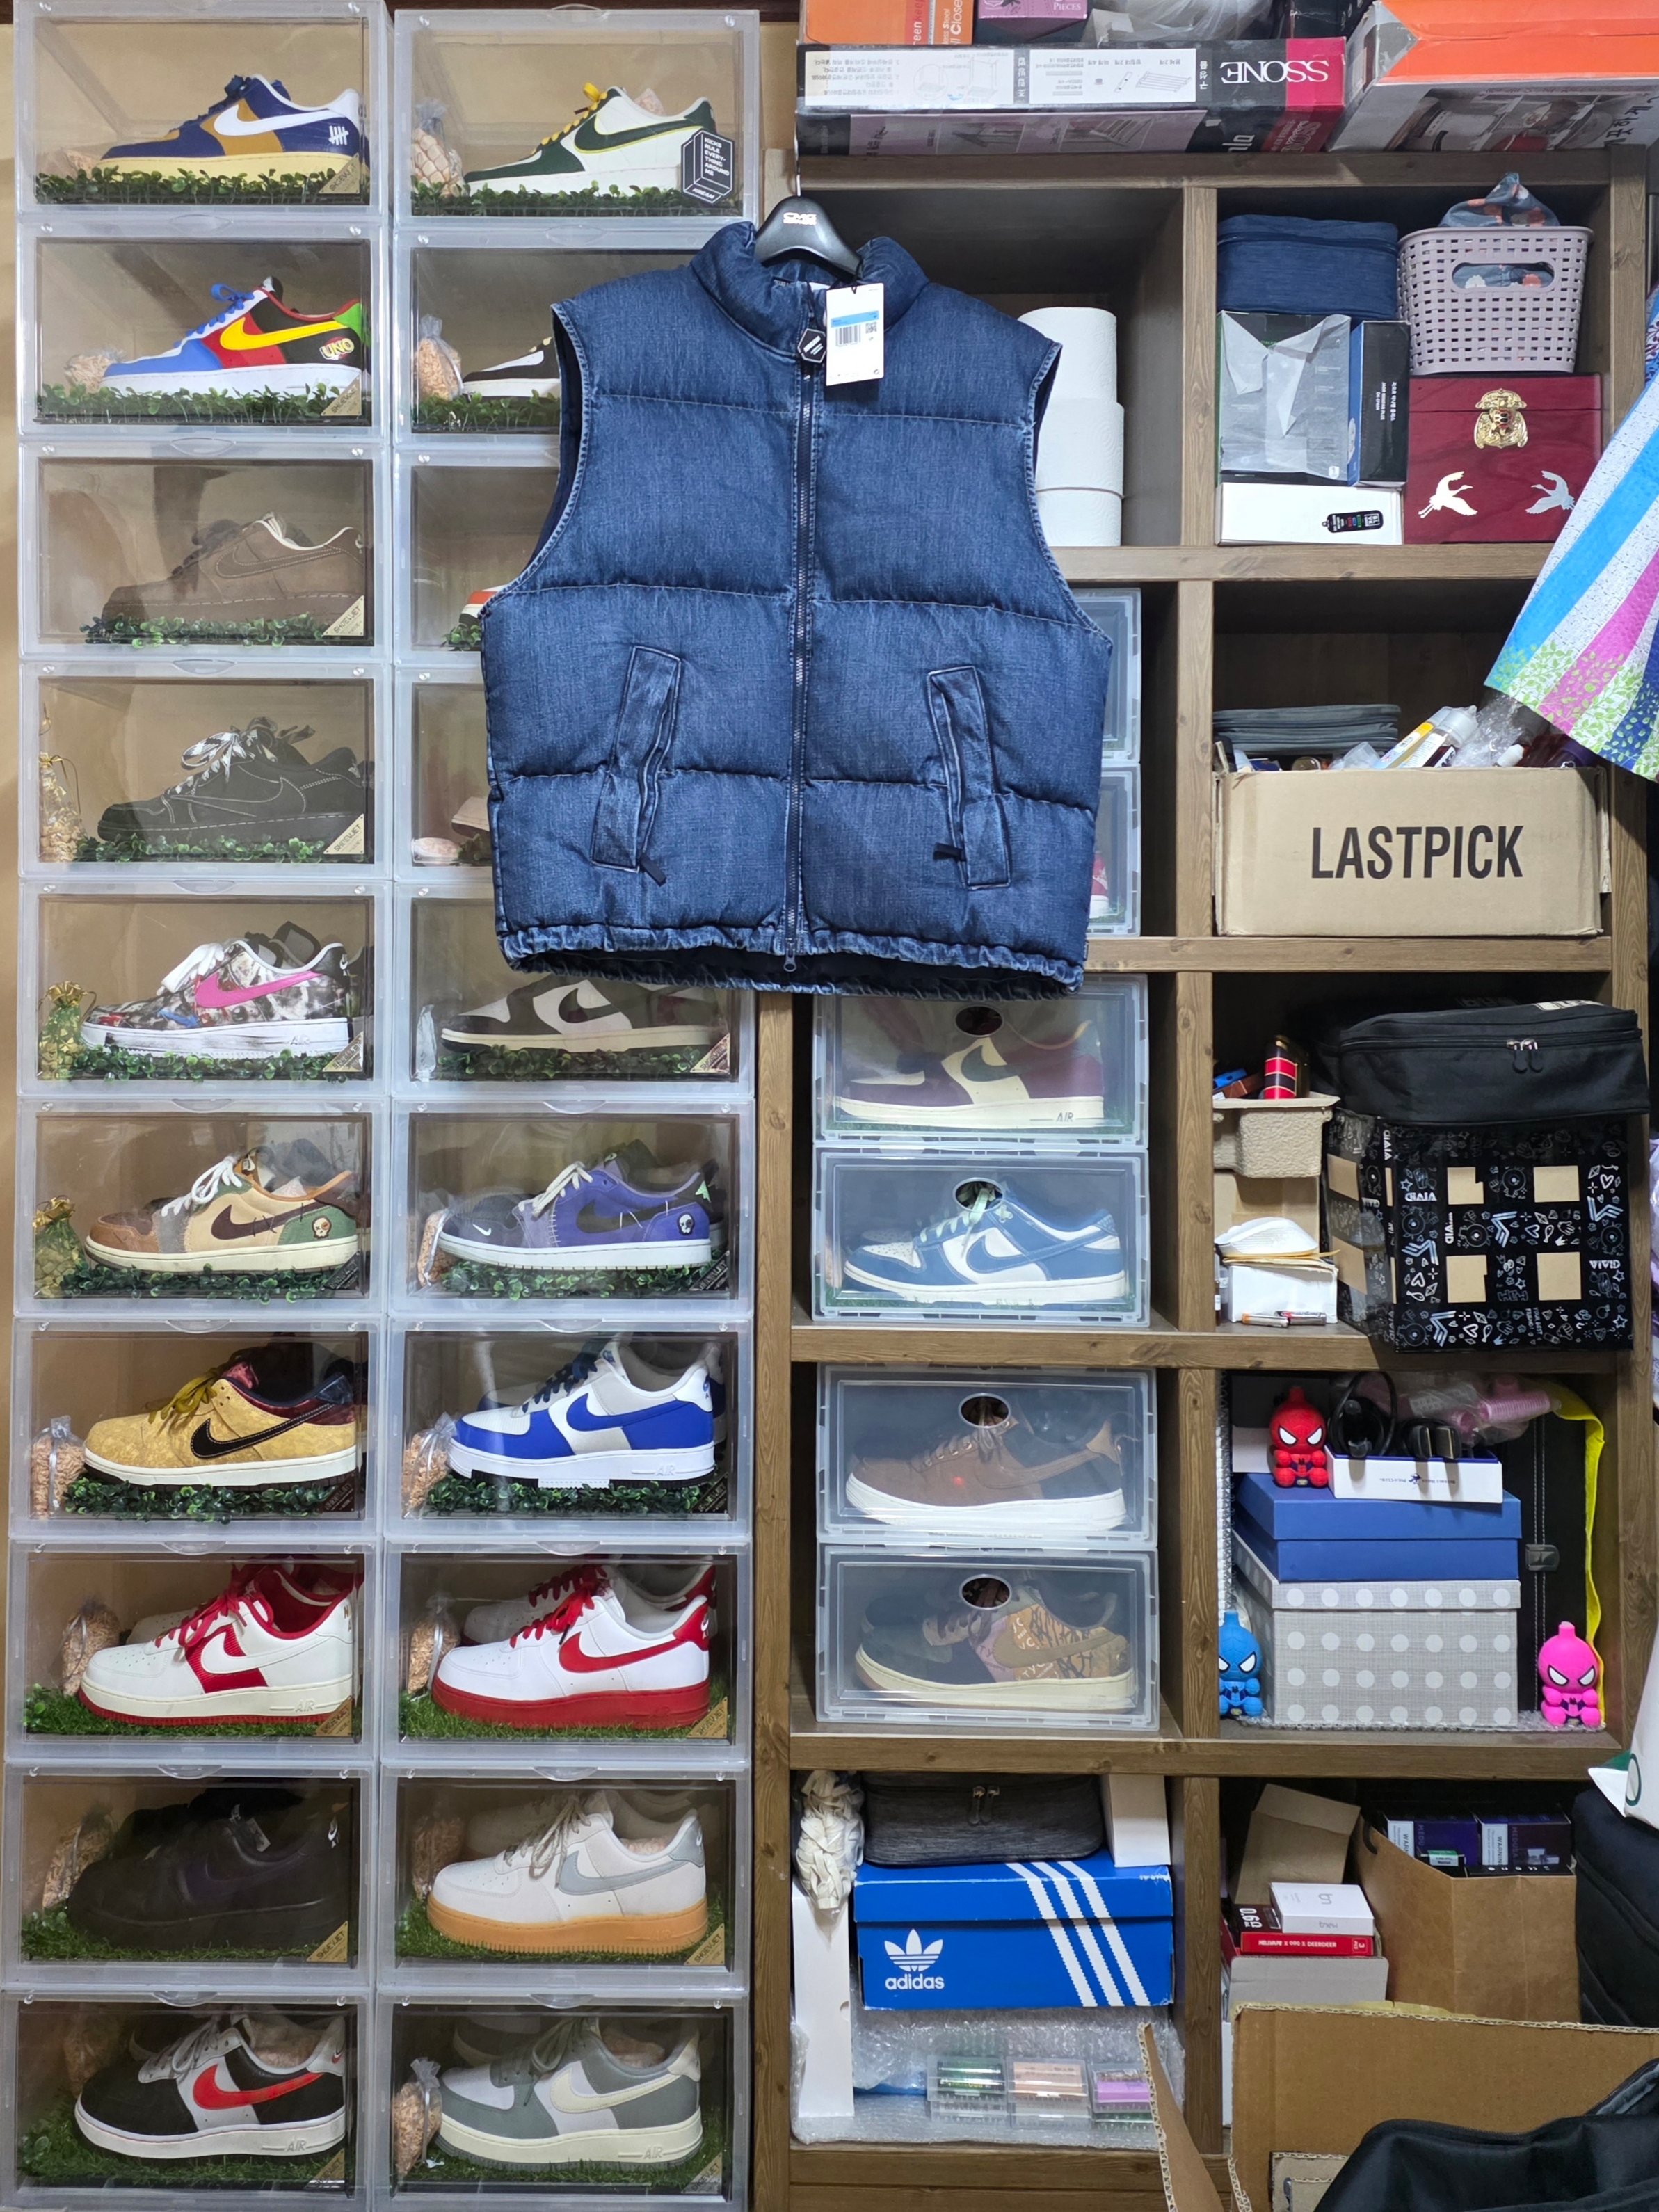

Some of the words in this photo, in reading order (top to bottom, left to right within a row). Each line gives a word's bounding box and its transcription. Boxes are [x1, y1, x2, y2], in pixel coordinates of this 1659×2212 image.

[1053, 2, 1082, 11] PIECES
[1199, 60, 1208, 90] 구성품
[1219, 59, 1329, 84] SSONE
[704, 137, 722, 148] KICKS
[704, 144, 721, 154] RULE
[704, 150, 726, 161] EVERY-
[704, 156, 723, 167] THING
[704, 162, 730, 177] AROUND
[704, 168, 714, 177] ME
[691, 188, 715, 200] KREAM
[320, 338, 355, 359] UNO
[333, 604, 362, 634] SHOEVJET
[334, 824, 362, 853] SHOEVJET
[1311, 825, 1524, 879] LASTPICK
[1055, 1112, 1074, 1123] AIR
[1404, 1192, 1437, 1202] VIVID
[1589, 1260, 1621, 1269] VIVID
[656, 1464, 675, 1476] AIR
[296, 1700, 316, 1713] AIR
[316, 1931, 345, 1959] SHOEVJET
[694, 1934, 723, 1964] SHOEVJET
[885, 1973, 945, 1991] adidas
[287, 2139, 307, 2152] AIR
[643, 2145, 664, 2159] AIR
